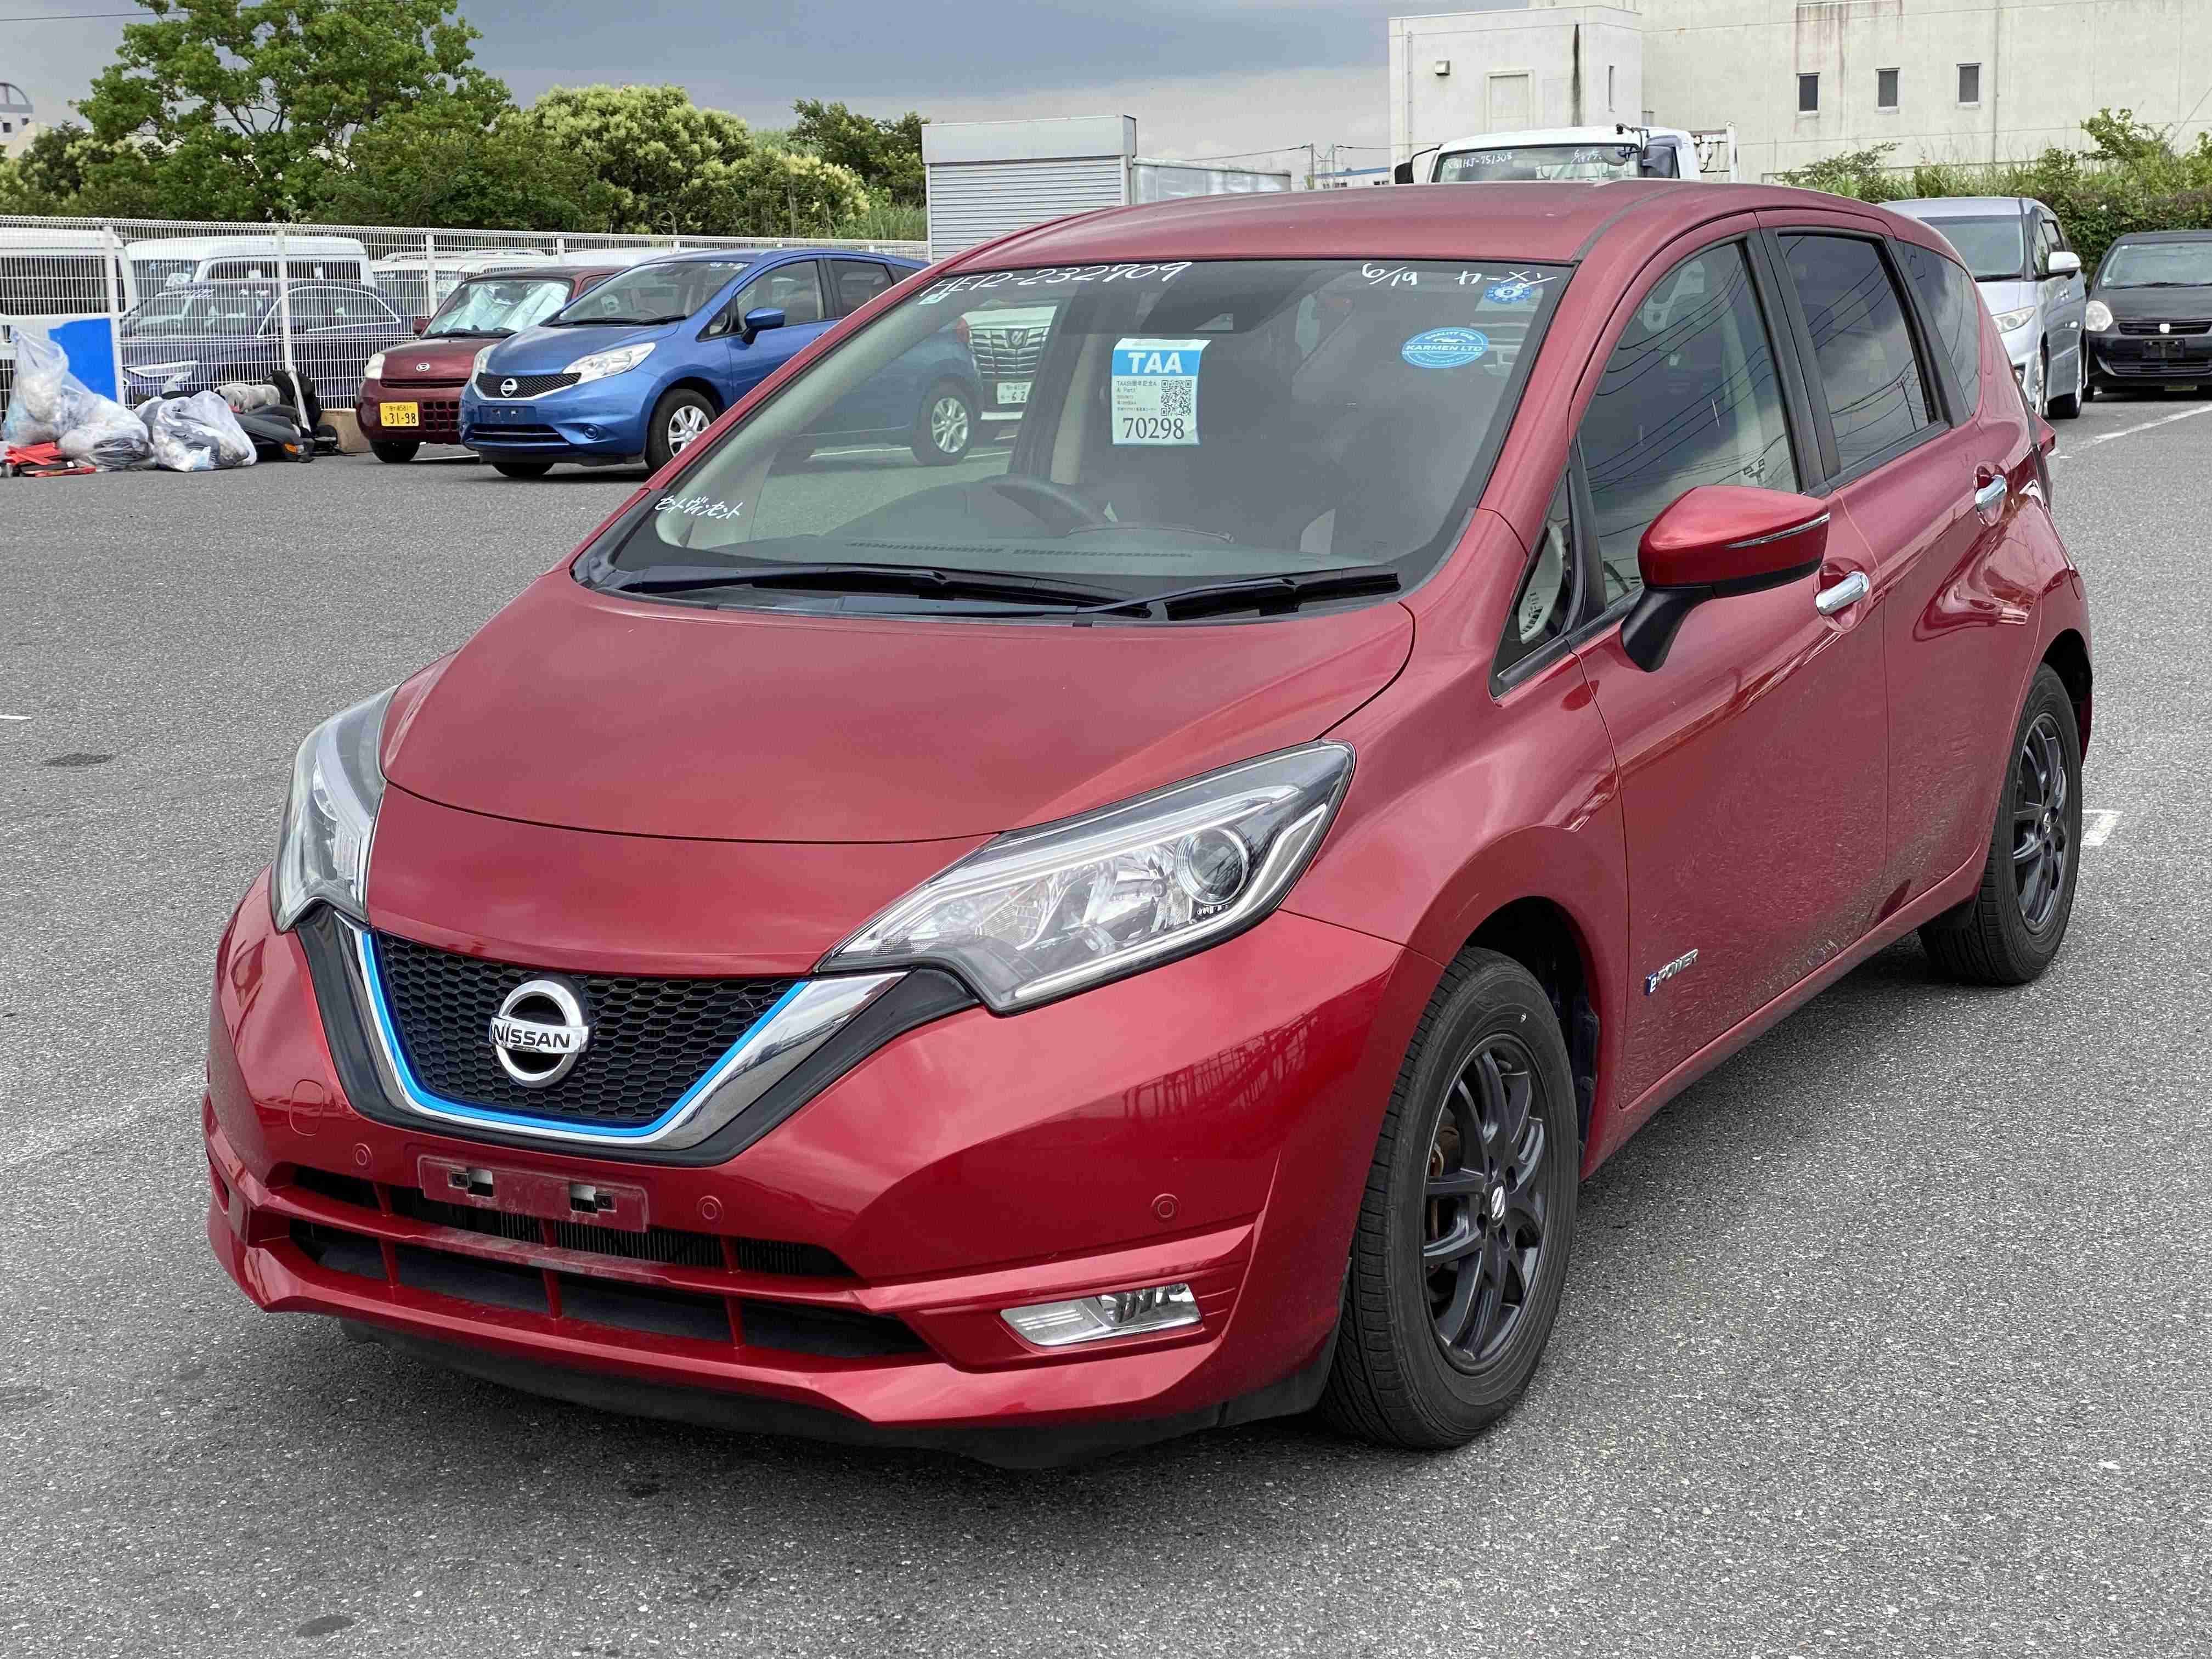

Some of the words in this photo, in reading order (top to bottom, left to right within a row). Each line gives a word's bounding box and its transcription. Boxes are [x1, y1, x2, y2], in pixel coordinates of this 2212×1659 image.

[919, 261, 1193, 297] HE12-232709
[1362, 263, 1418, 286] 6/19
[1127, 352, 1183, 374] TAA
[389, 412, 416, 424] 31-98
[1123, 417, 1185, 439] 70298
[493, 1023, 571, 1048] NISSAN
